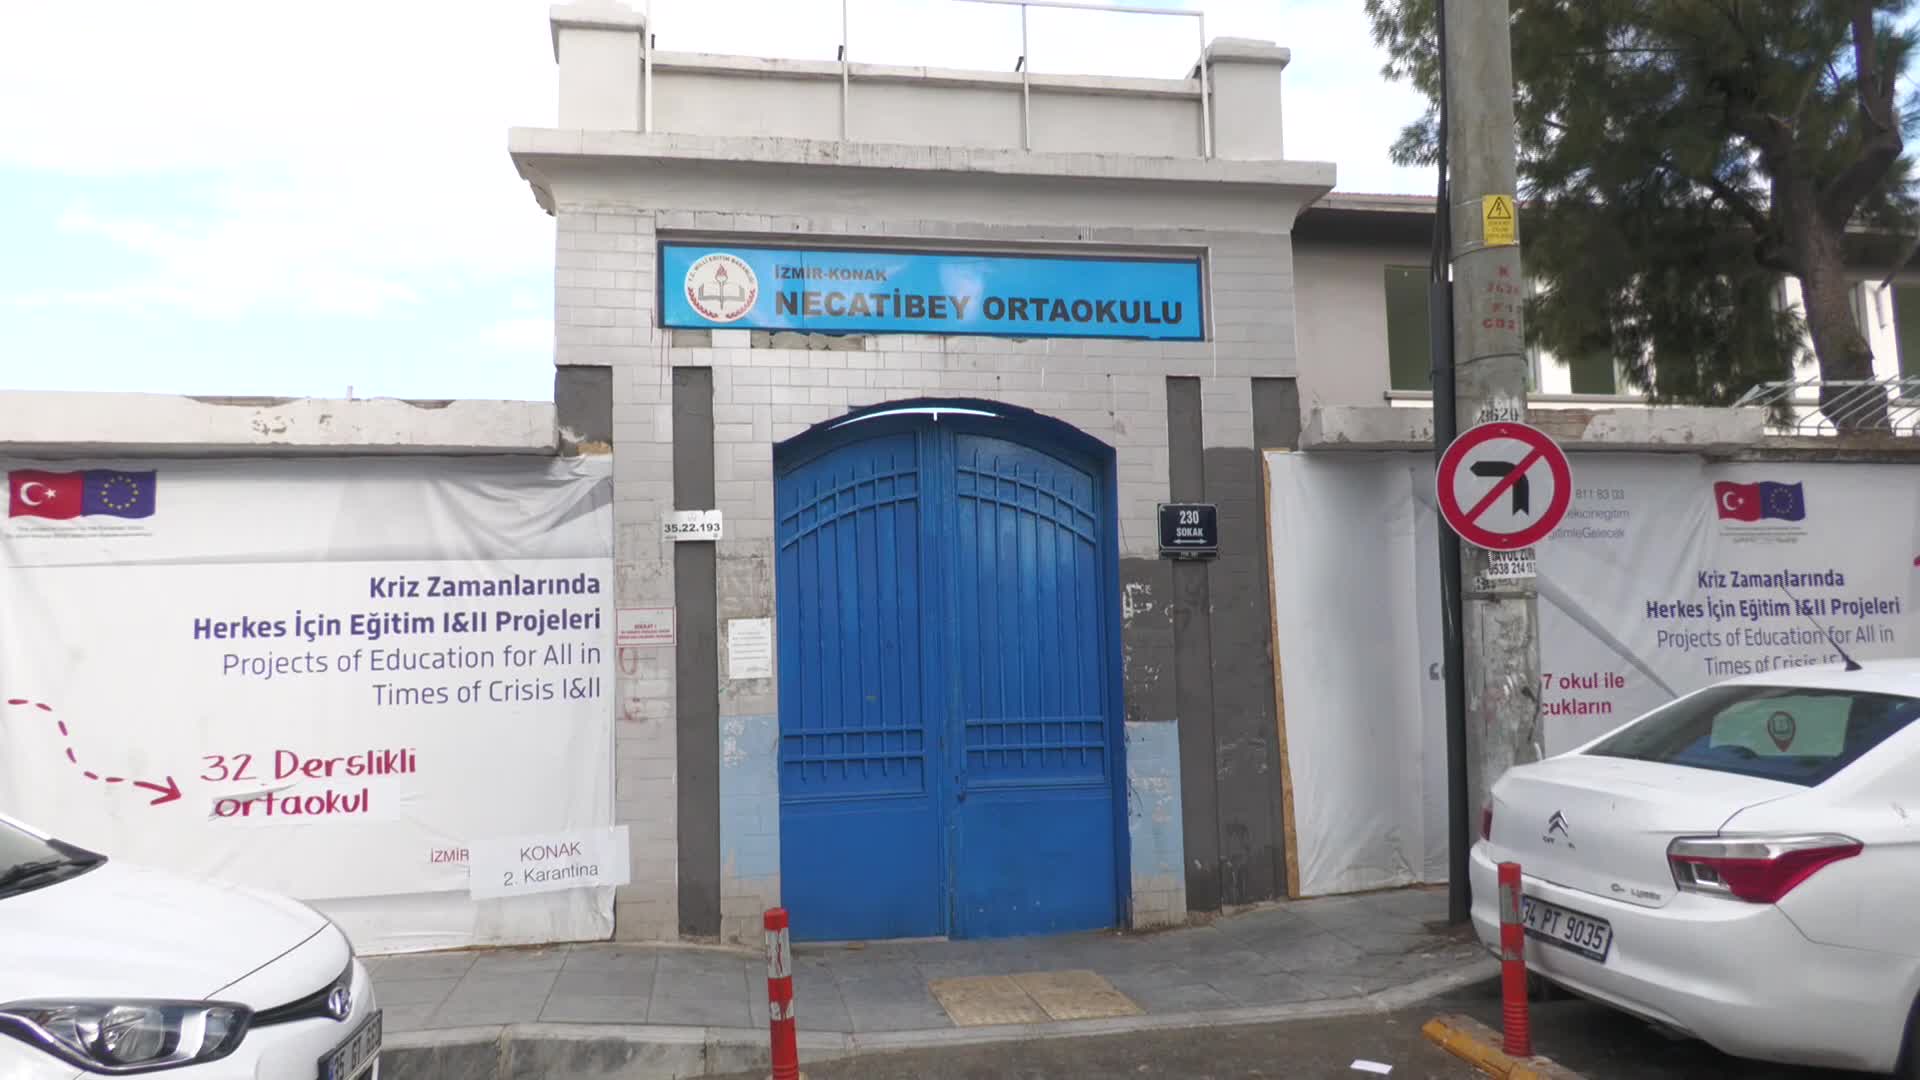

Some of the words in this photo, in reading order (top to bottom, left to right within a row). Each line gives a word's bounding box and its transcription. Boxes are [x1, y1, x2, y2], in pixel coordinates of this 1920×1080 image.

[775, 264, 887, 282] İZMİR-KONAK
[775, 288, 970, 321] NECATİBEY
[983, 296, 1182, 324] ORTAOKULU
[664, 523, 720, 533] 35.22.193
[1180, 510, 1199, 525] 230
[1176, 527, 1204, 537] SOKAK
[369, 575, 420, 598] Kriz
[427, 573, 600, 597] Zamanlarında
[1698, 570, 1727, 589] Kriz
[1730, 569, 1845, 588] Zamanlarında
[1647, 599, 1704, 619] Herkes
[1707, 596, 1736, 622] İçin
[1740, 597, 1791, 621] Eğitim
[1796, 600, 1826, 616] I&II
[1831, 596, 1901, 619] Projeleri
[193, 616, 287, 640] Herkes
[295, 610, 341, 642] İçin
[350, 612, 435, 640] Eğitim
[443, 611, 487, 633] I&II
[496, 608, 600, 637] Projeleri
[1657, 628, 1722, 652] Projects
[1726, 627, 1742, 647] of
[1745, 626, 1824, 647] Education
[1829, 625, 1851, 645] for
[1855, 623, 1876, 643] All
[1879, 623, 1895, 643] in
[223, 652, 328, 680] Projects
[337, 649, 362, 672] of
[371, 646, 494, 671] Education
[504, 645, 537, 667] for
[543, 643, 572, 666] All
[581, 643, 600, 664] in
[1703, 655, 1751, 677] Times
[1755, 655, 1771, 674] of
[372, 681, 449, 706] Times
[457, 680, 482, 703] of
[489, 678, 554, 702] Crisis
[563, 677, 600, 699] I&II
[1559, 673, 1599, 689] okul
[1604, 672, 1625, 689] ile
[1542, 699, 1612, 716] cukların
[200, 753, 257, 781] 32
[275, 748, 416, 779] Derslikli
[215, 788, 368, 817] ortaokul
[430, 847, 470, 863] İZMİR
[520, 841, 582, 862] KONAK
[503, 870, 518, 887] 2.
[524, 863, 599, 884] Karantina
[1541, 908, 1562, 935] PT
[1564, 916, 1605, 949] 9035
